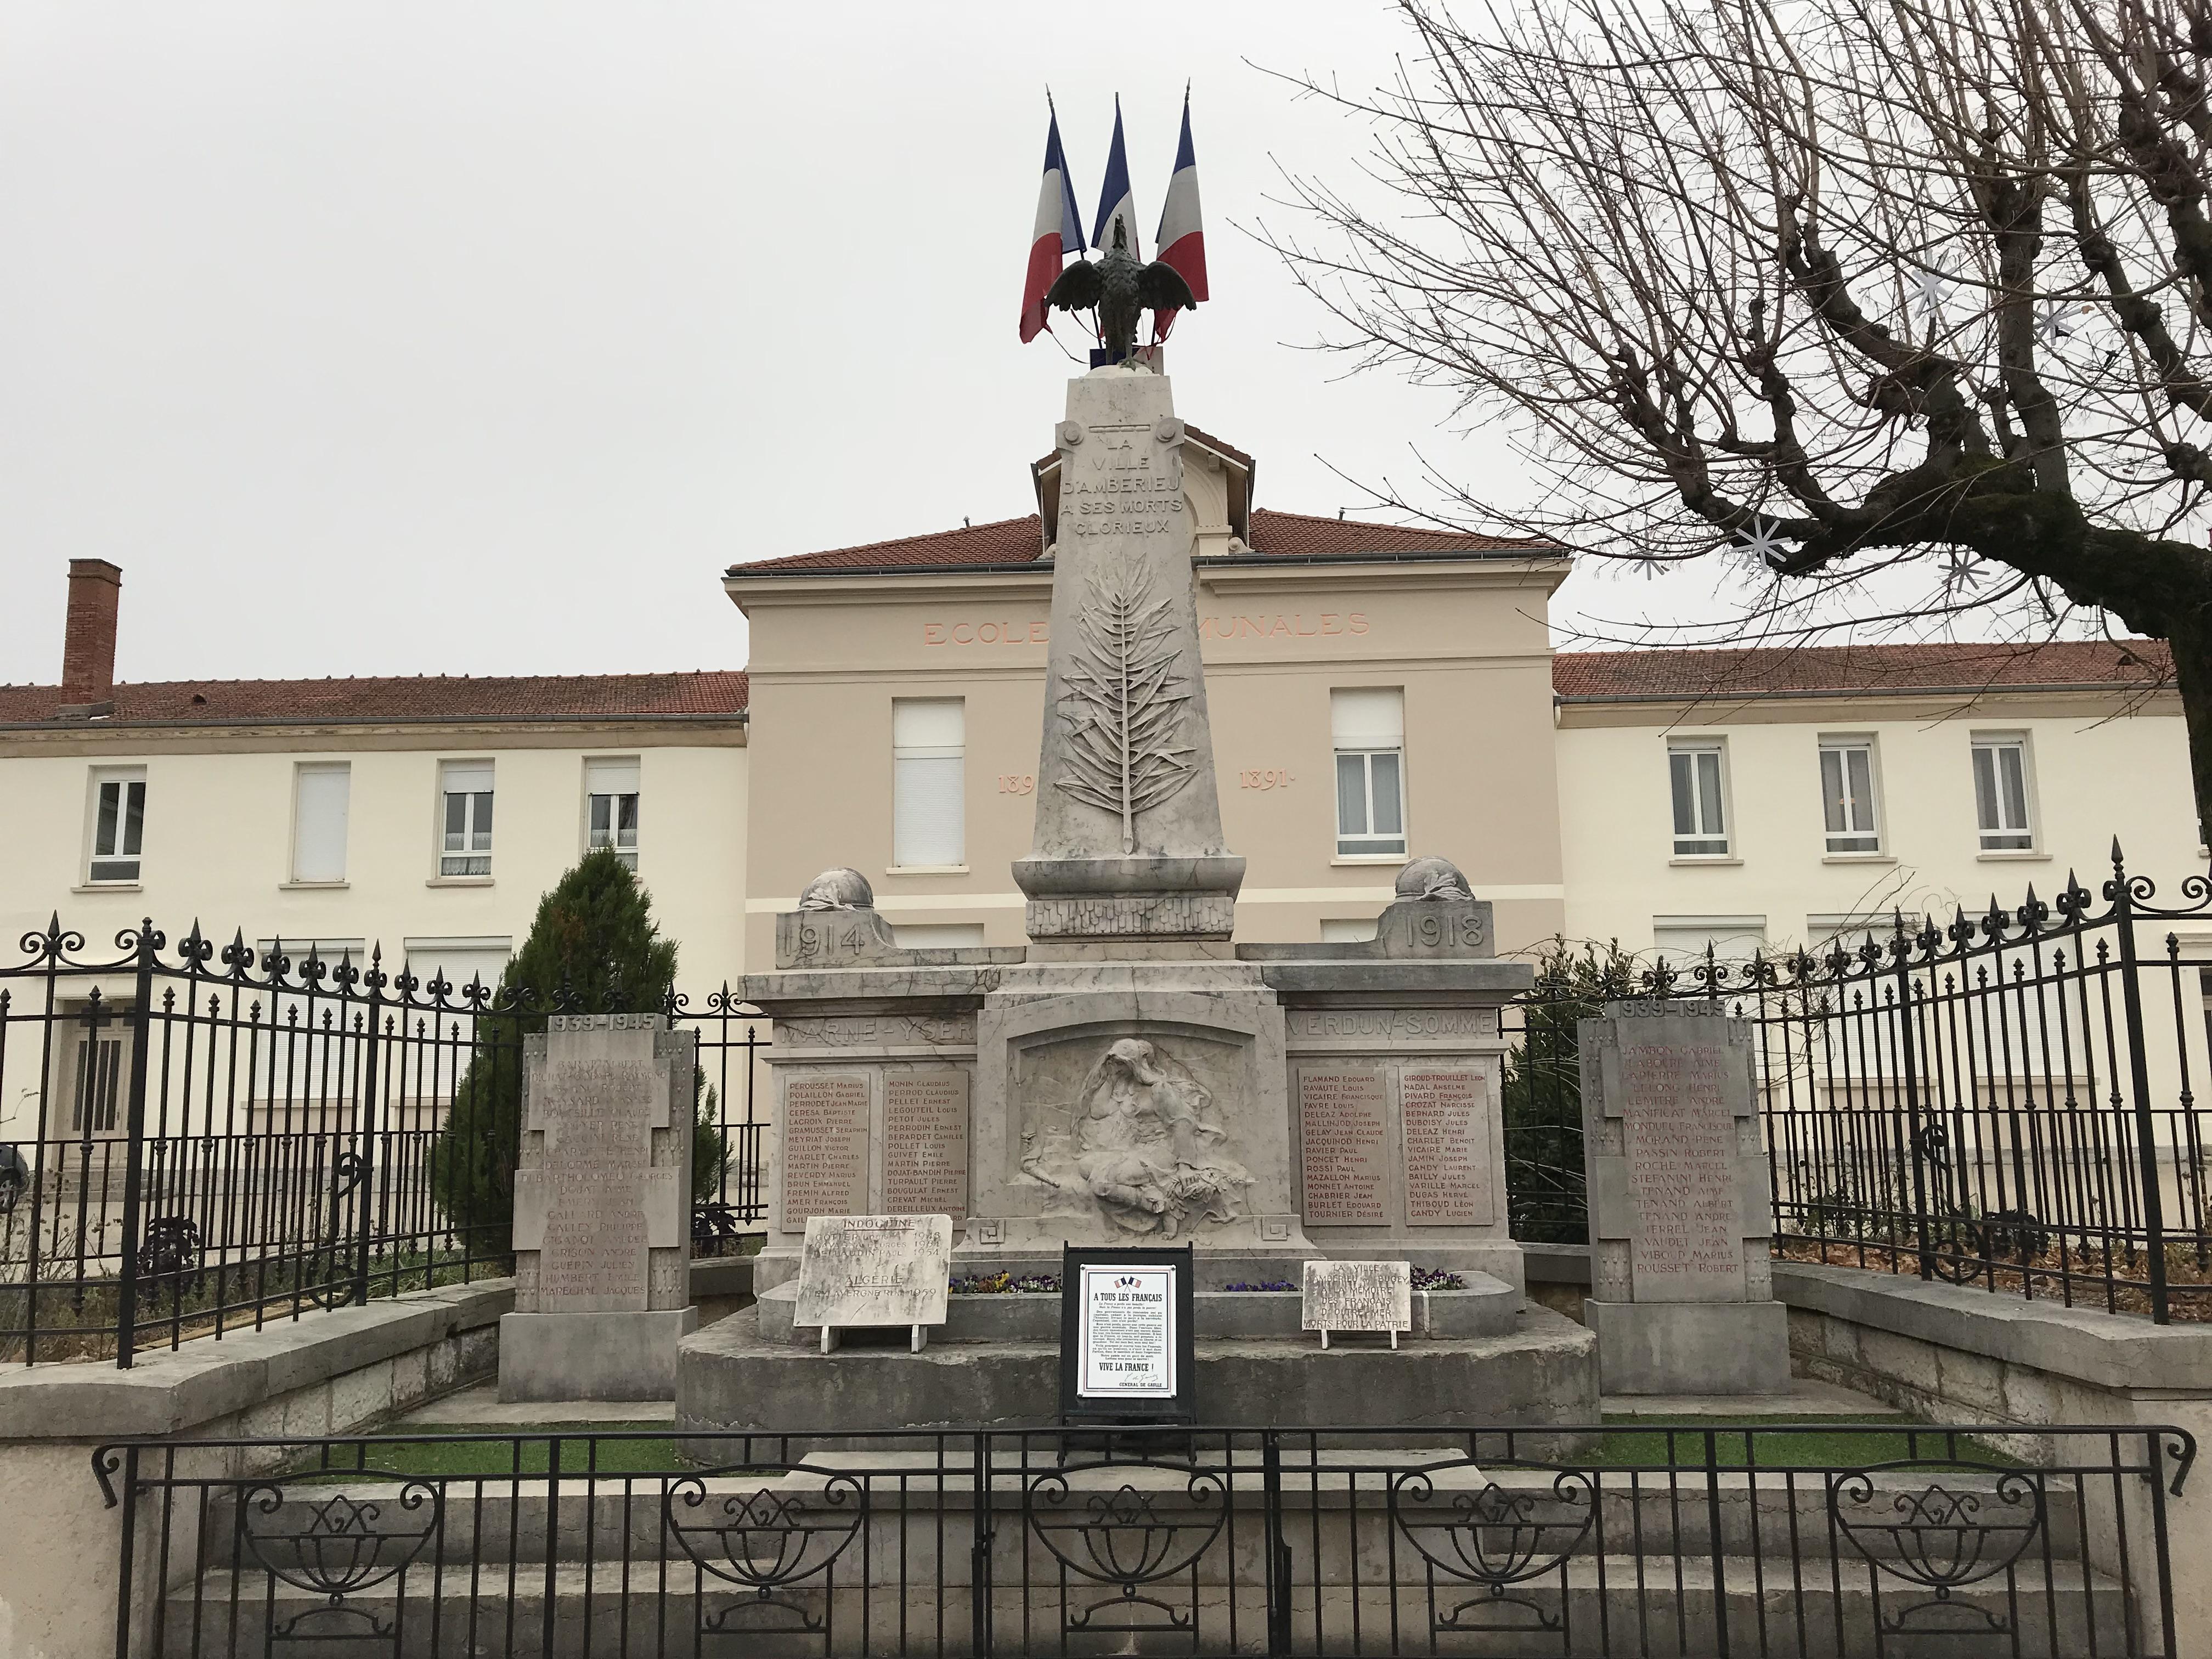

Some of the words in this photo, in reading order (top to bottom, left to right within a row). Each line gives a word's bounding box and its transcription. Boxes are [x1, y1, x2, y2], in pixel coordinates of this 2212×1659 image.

[1108, 439, 1132, 449] LA
[1092, 457, 1149, 470] VILLE
[1061, 505, 1073, 515] A
[1079, 501, 1115, 514] SES
[1121, 500, 1182, 513] MORTS
[1407, 916, 1482, 946] 1918
[785, 924, 865, 956] 1914
[1623, 1046, 1673, 1054] JAMBON
[1624, 1109, 1685, 1117] MANIFICAT
[1637, 1136, 1688, 1144] MORAND
[1635, 1162, 1677, 1170] ROCHE
[1638, 1264, 1690, 1273] ROUSSET
[845, 1276, 903, 1284] ALGERIE
[1132, 1294, 1162, 1302] FRANÇAIS
[1304, 1320, 1333, 1328] MORTS
